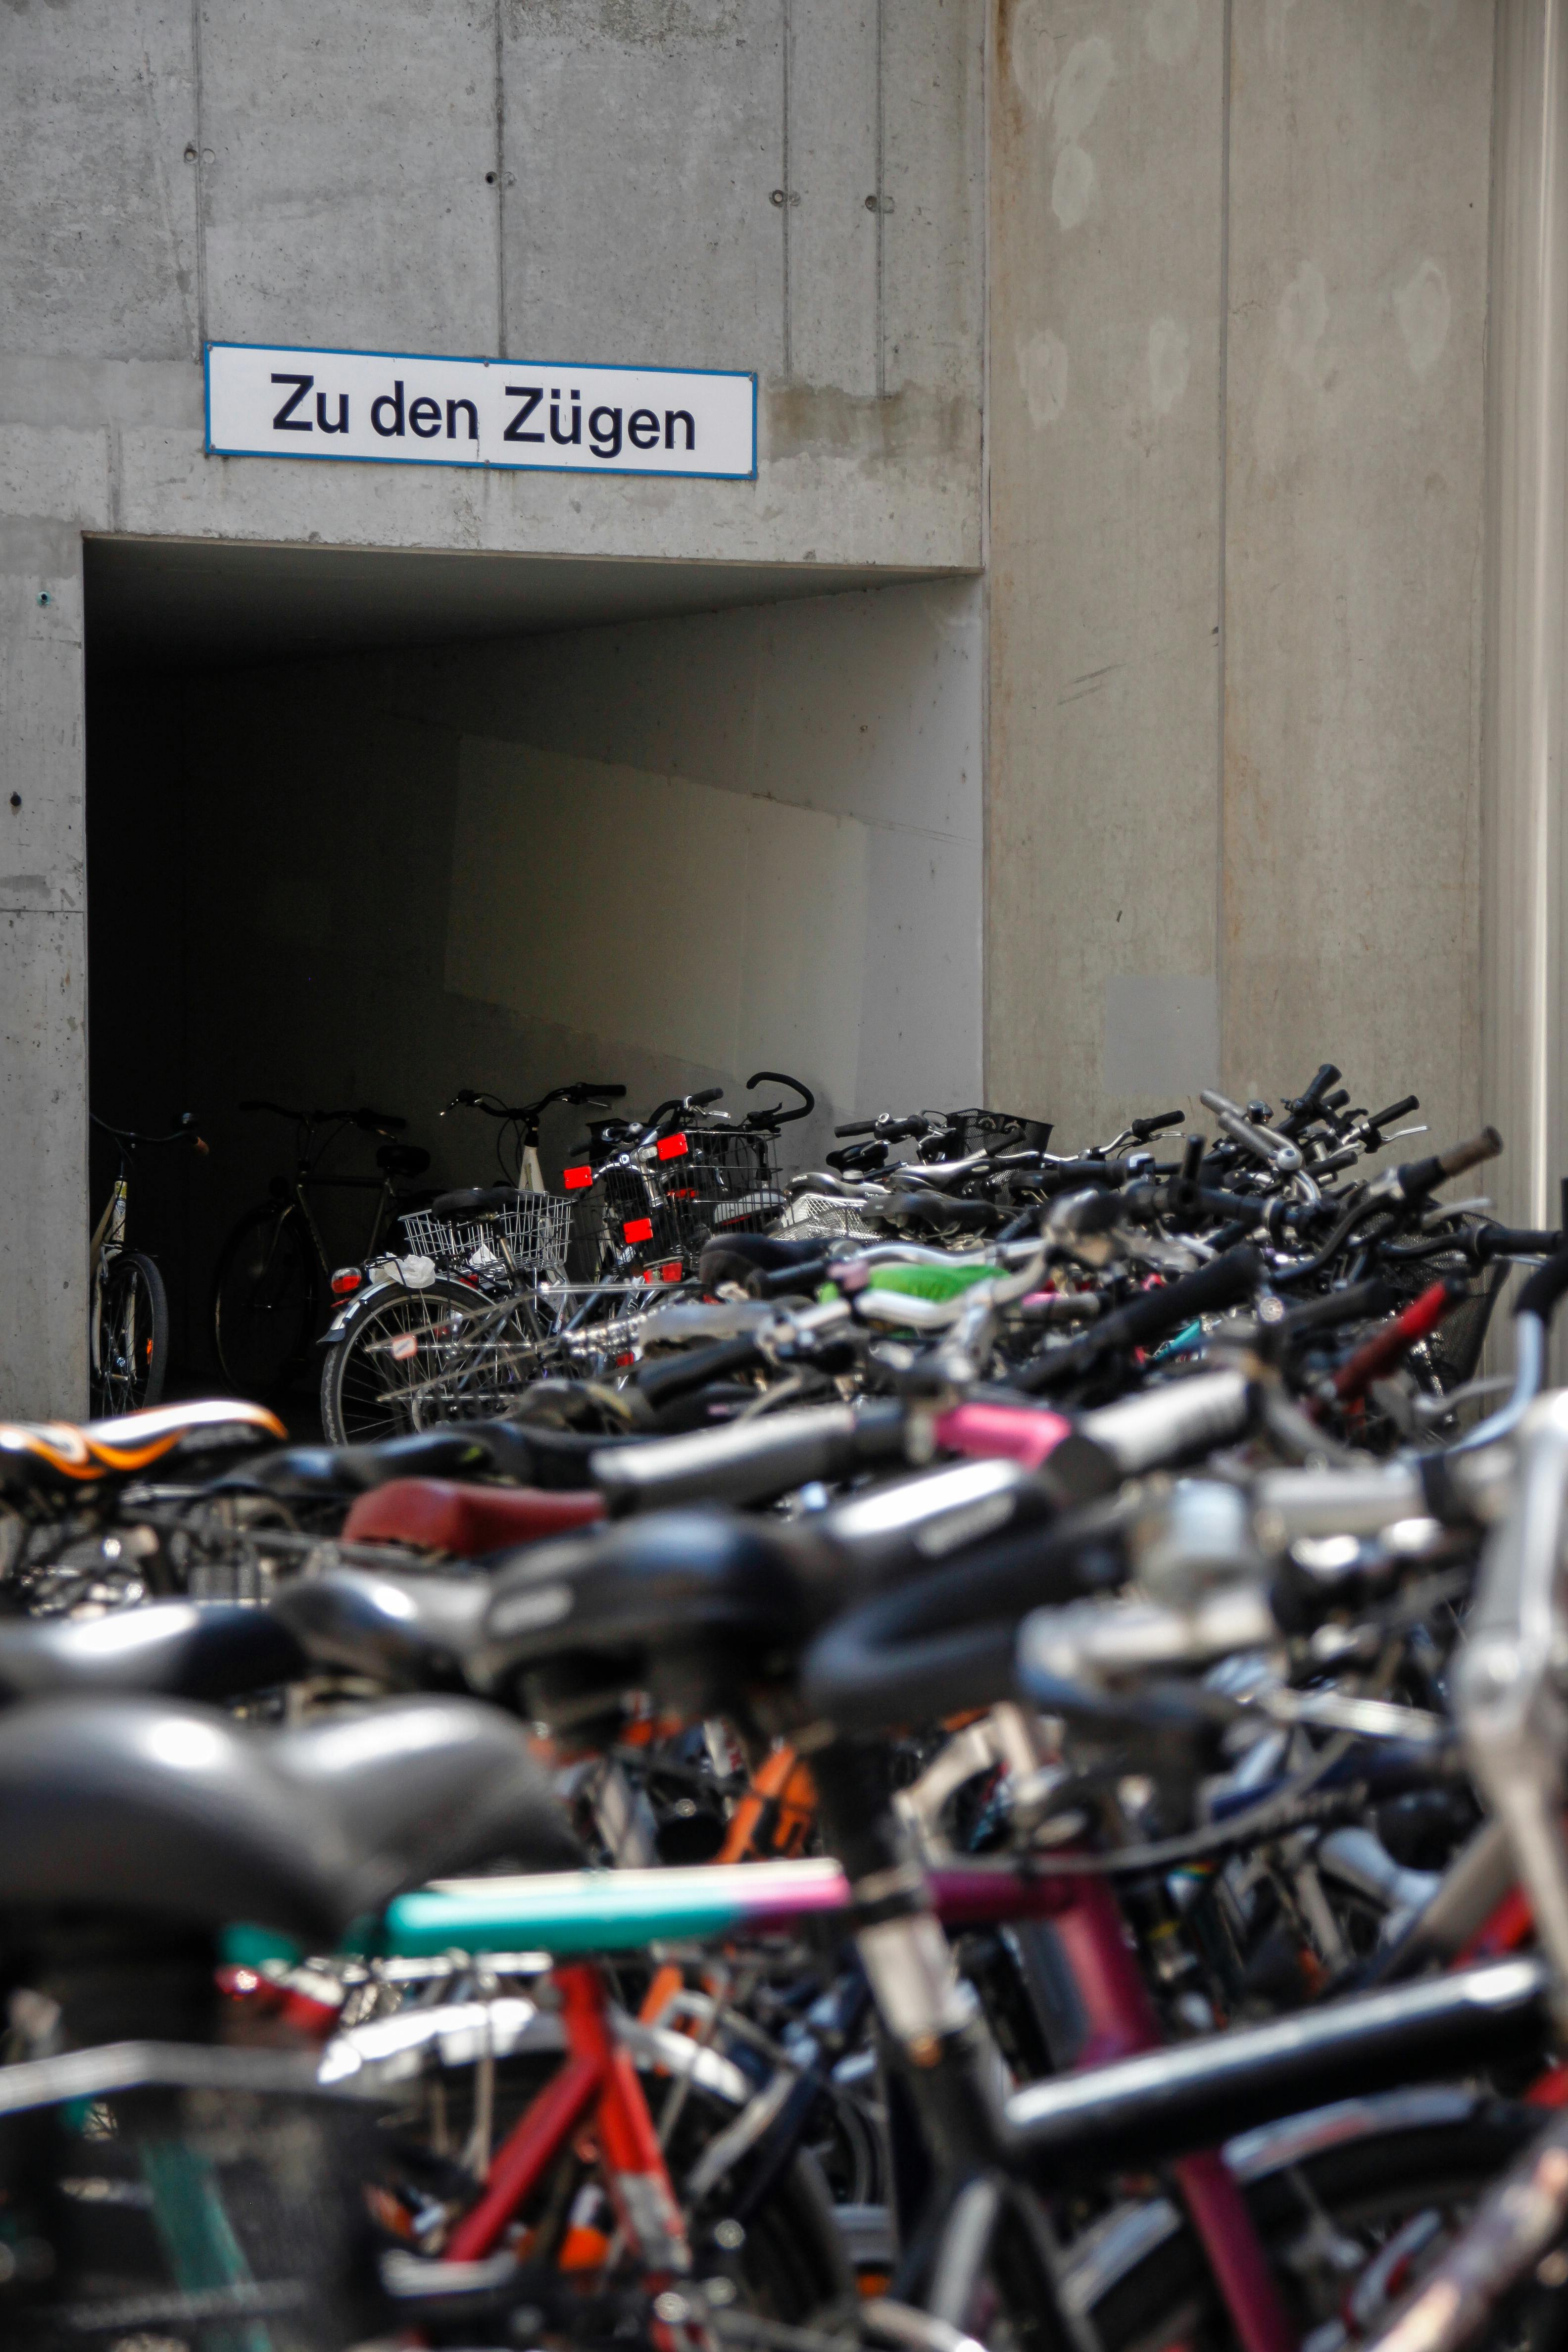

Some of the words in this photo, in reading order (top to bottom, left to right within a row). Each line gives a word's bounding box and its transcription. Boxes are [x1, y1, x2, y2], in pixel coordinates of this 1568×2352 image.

[270, 373, 349, 434] Zu
[370, 380, 479, 441] den
[503, 385, 695, 459] Zügen
